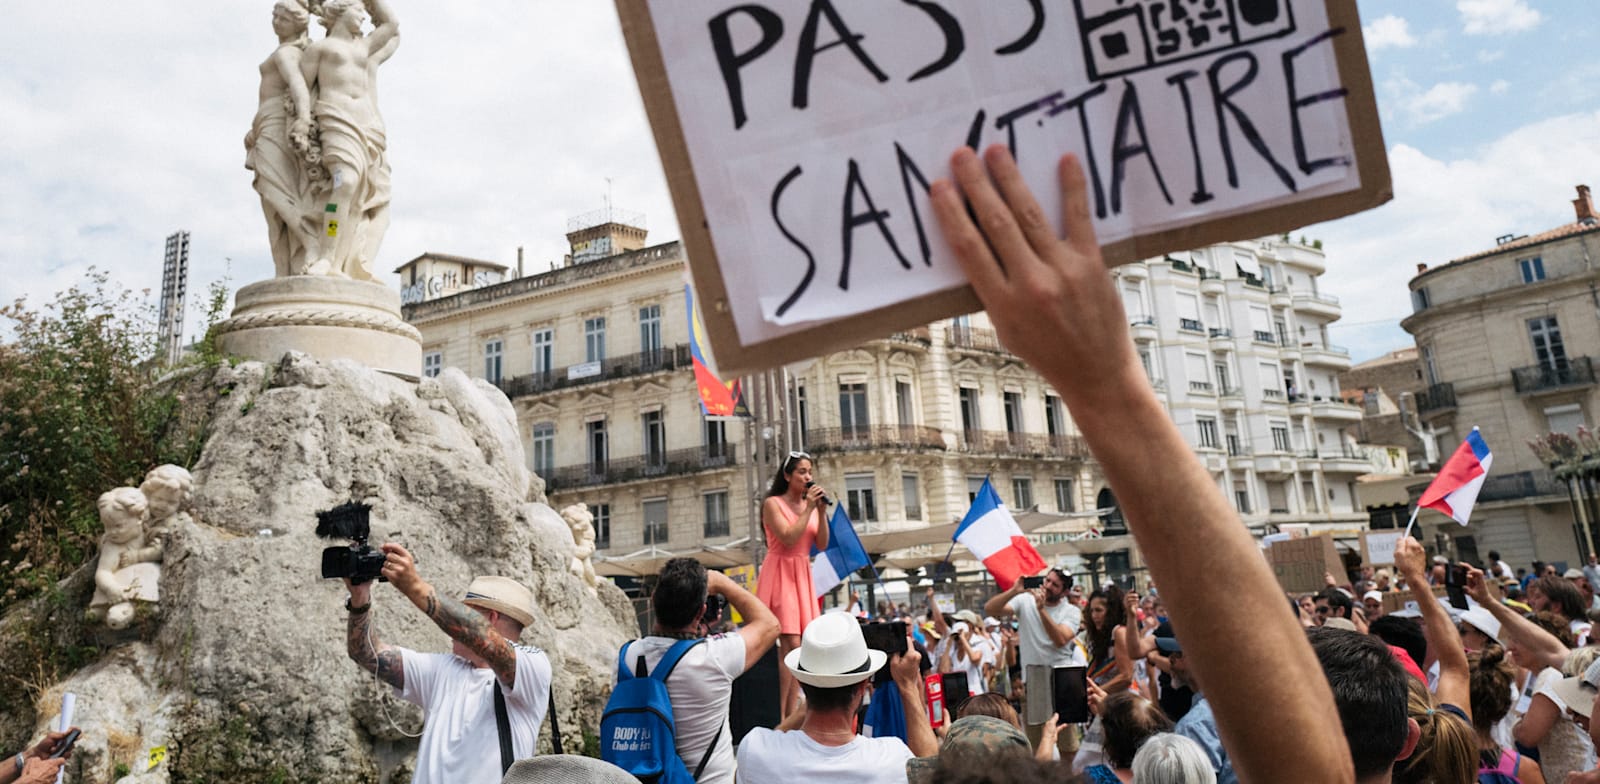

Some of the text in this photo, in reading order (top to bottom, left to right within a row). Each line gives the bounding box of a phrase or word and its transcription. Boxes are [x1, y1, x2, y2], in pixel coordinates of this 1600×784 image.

[613, 727, 640, 740] BODY
[612, 740, 629, 751] Club
[629, 741, 639, 751] de
